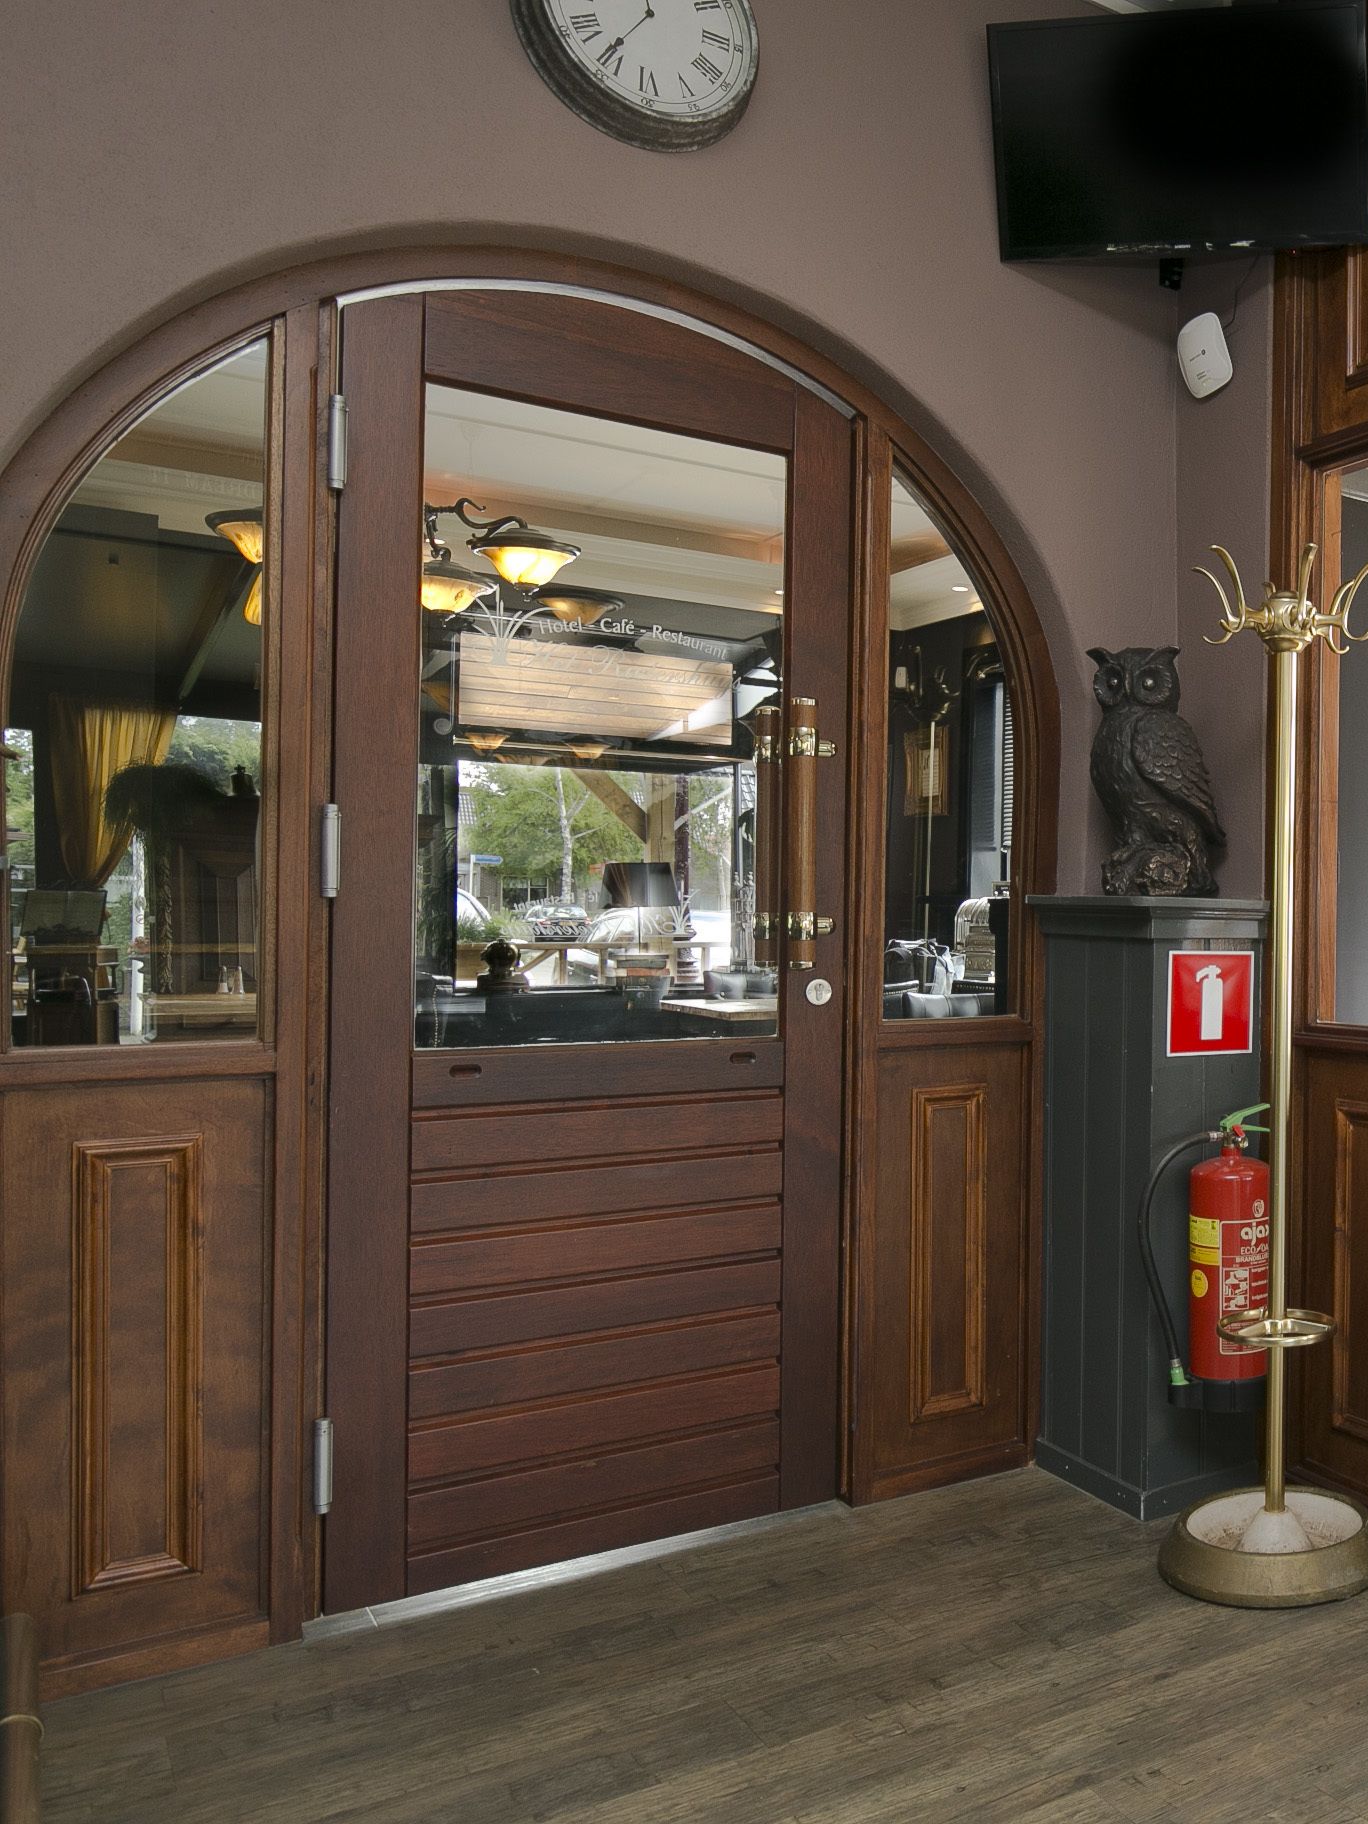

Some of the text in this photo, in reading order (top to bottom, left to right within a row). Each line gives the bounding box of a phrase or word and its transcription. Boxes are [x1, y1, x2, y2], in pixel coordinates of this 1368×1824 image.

[569, 12, 604, 45] VIII
[702, 27, 730, 53] III
[595, 43, 624, 77] VII
[691, 52, 723, 85] IIII
[639, 65, 660, 97] VI
[677, 72, 697, 98] V
[538, 616, 583, 635] Hotel
[600, 617, 635, 635] Café
[652, 625, 728, 660] Restaurant
